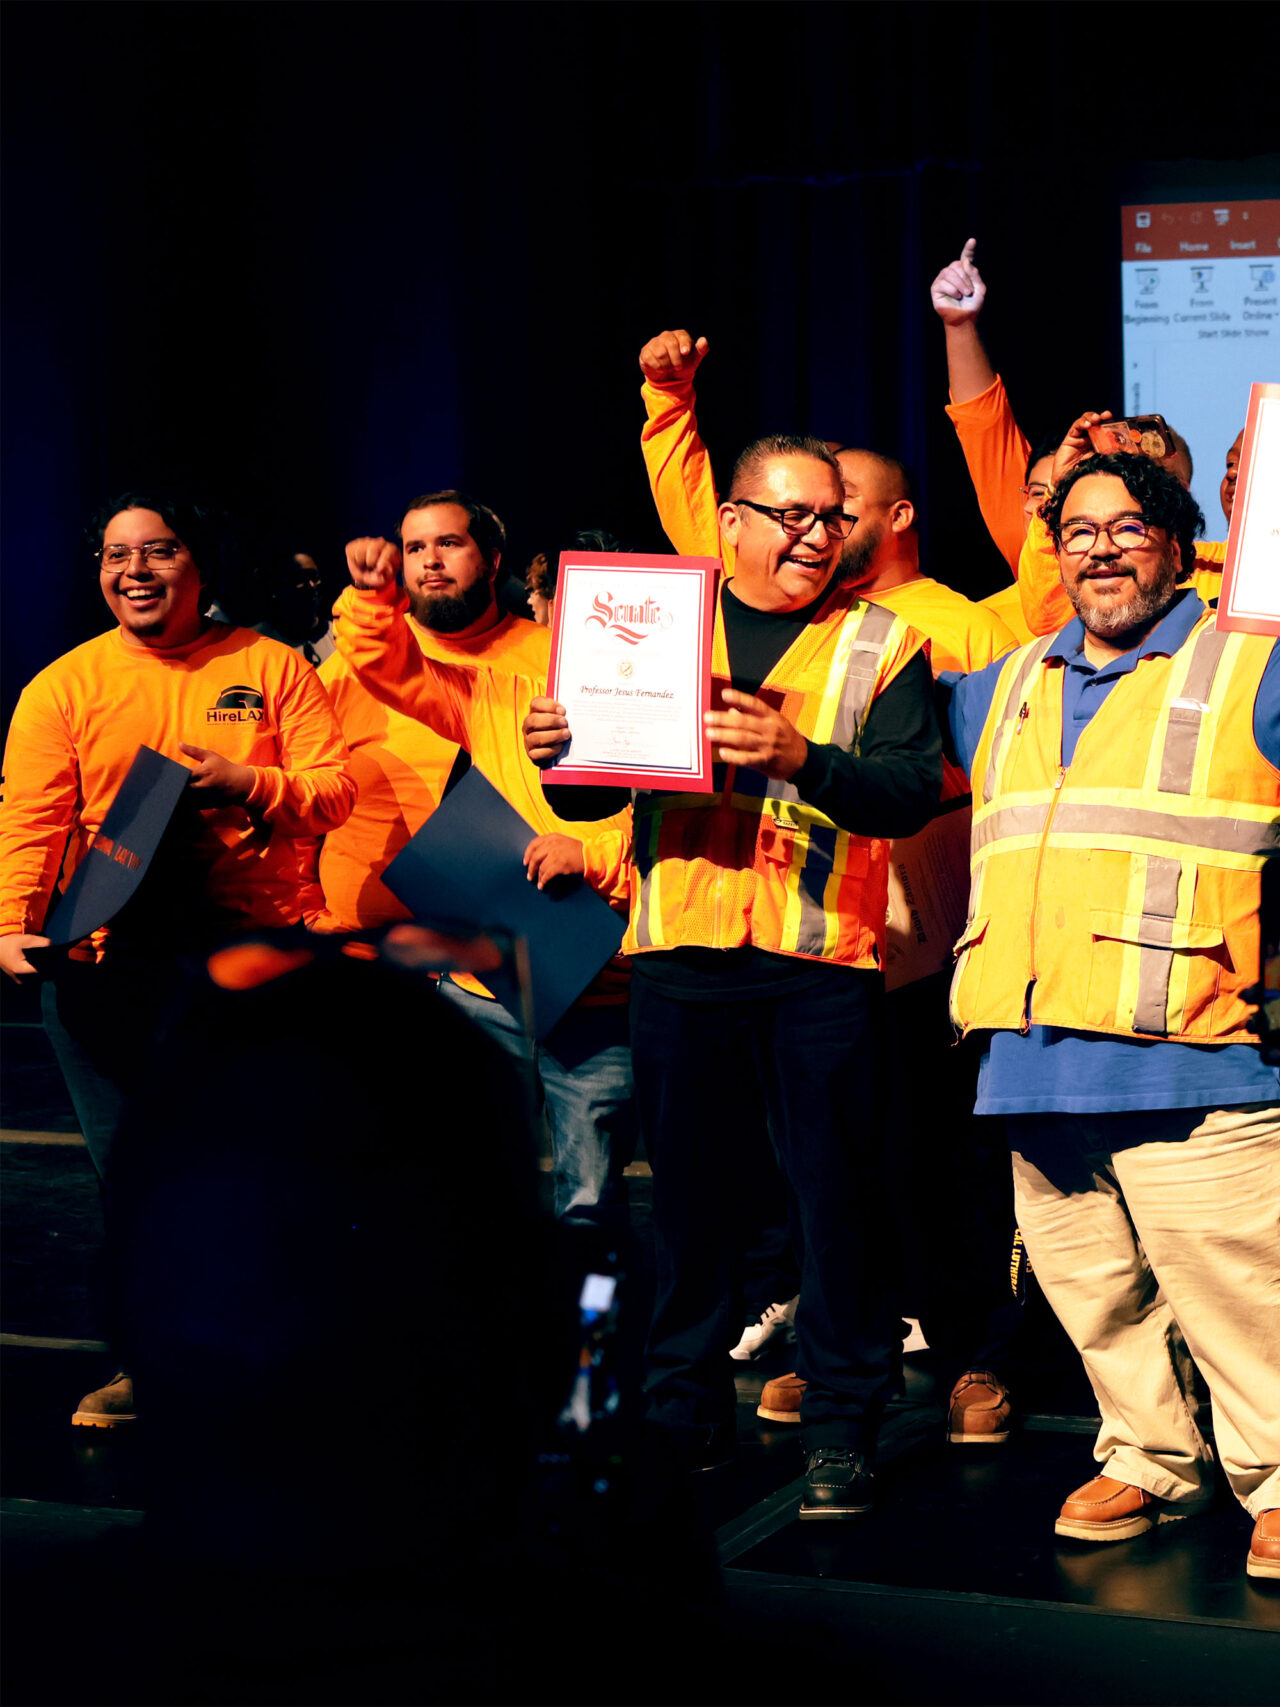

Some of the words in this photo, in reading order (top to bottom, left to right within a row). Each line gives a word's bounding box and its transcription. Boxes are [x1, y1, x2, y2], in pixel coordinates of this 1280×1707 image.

[1135, 242, 1153, 253] File
[1179, 241, 1209, 252] Home
[1230, 239, 1256, 250] Insert
[1189, 298, 1215, 308] From
[1243, 296, 1277, 306] Present
[1124, 314, 1170, 326] Beginning
[1173, 312, 1207, 323] Current
[1209, 311, 1231, 321] Slide
[1243, 310, 1273, 320] Online
[585, 591, 664, 630] Senate
[580, 684, 613, 697] Professor
[613, 686, 634, 698] Jesus
[635, 688, 676, 700] Fernandez
